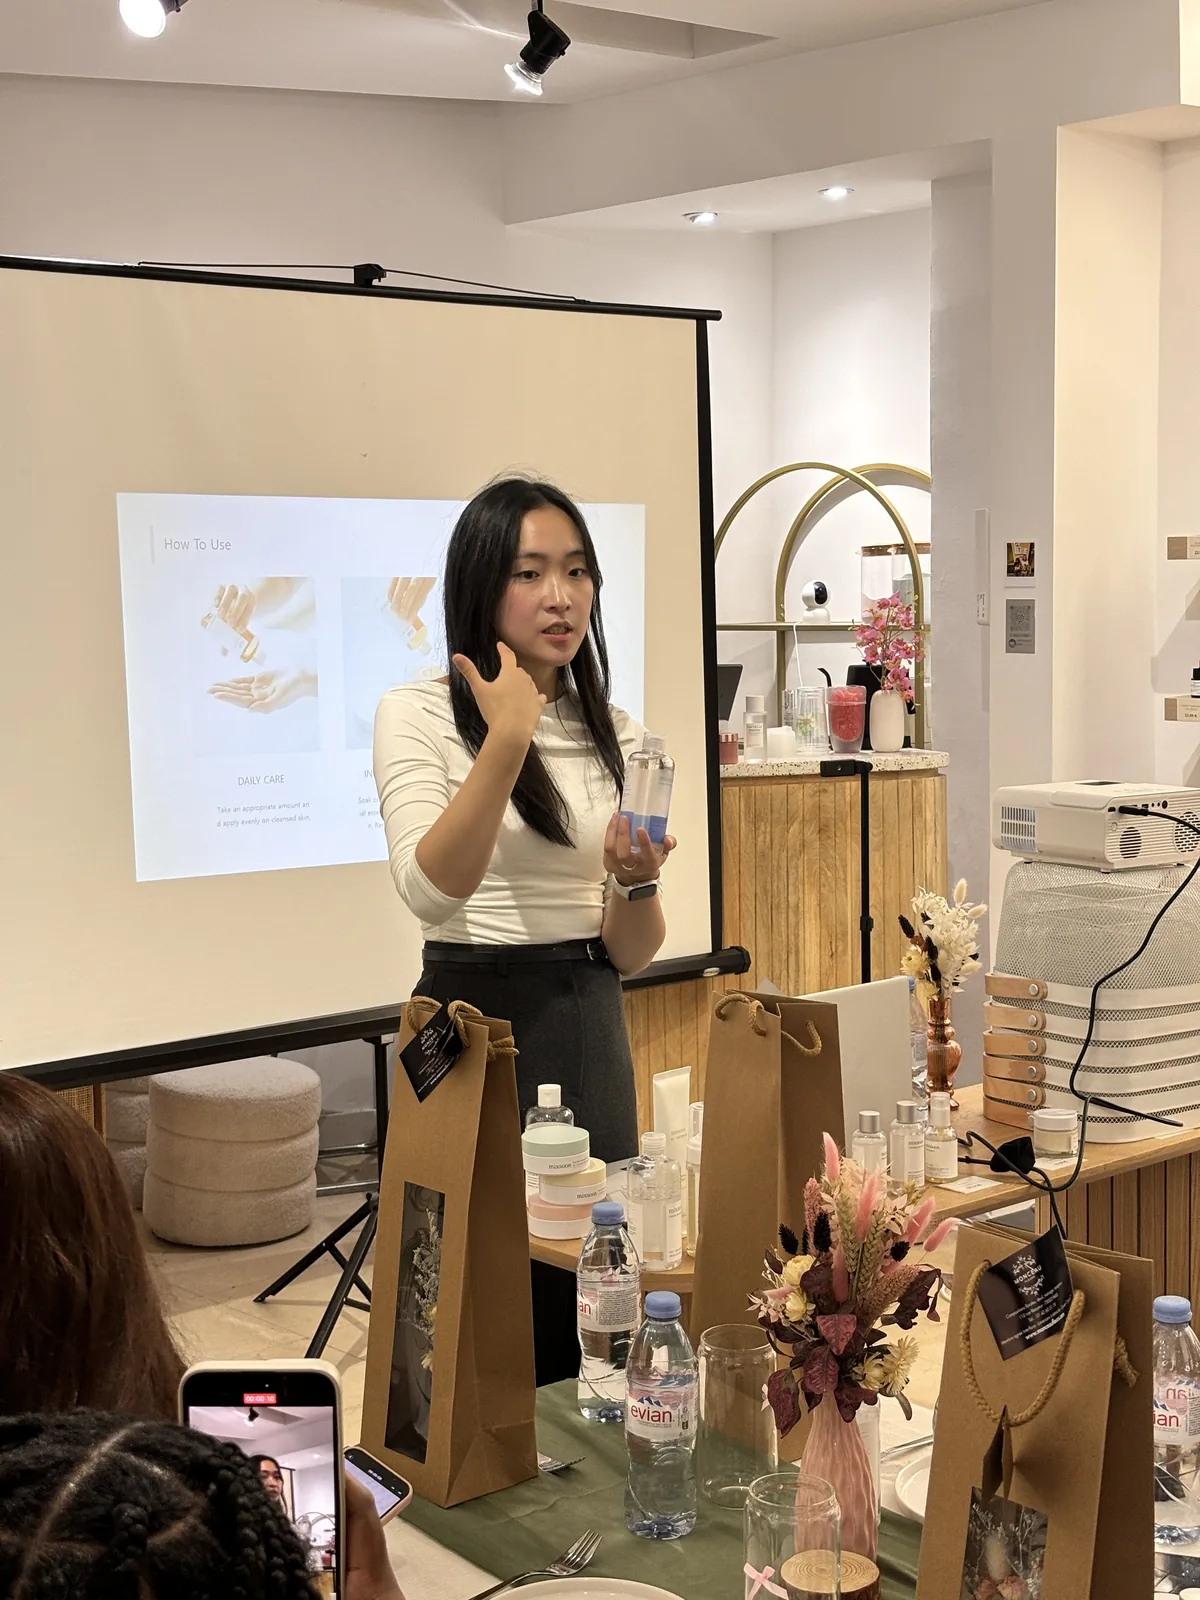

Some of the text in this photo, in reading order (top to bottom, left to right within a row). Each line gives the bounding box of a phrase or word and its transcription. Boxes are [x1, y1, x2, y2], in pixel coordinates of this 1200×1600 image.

[164, 538, 231, 551] How To Use
[238, 774, 285, 786] DAILY CARE
[242, 803, 277, 813] appropriate
[223, 819, 239, 828] apply
[241, 817, 260, 826] evenly
[271, 814, 297, 823] cleansed
[576, 1191, 598, 1199] mixsoon
[1013, 1264, 1042, 1284] MONCEAU
[631, 1405, 672, 1423] evian
[1152, 1411, 1179, 1427] ian
